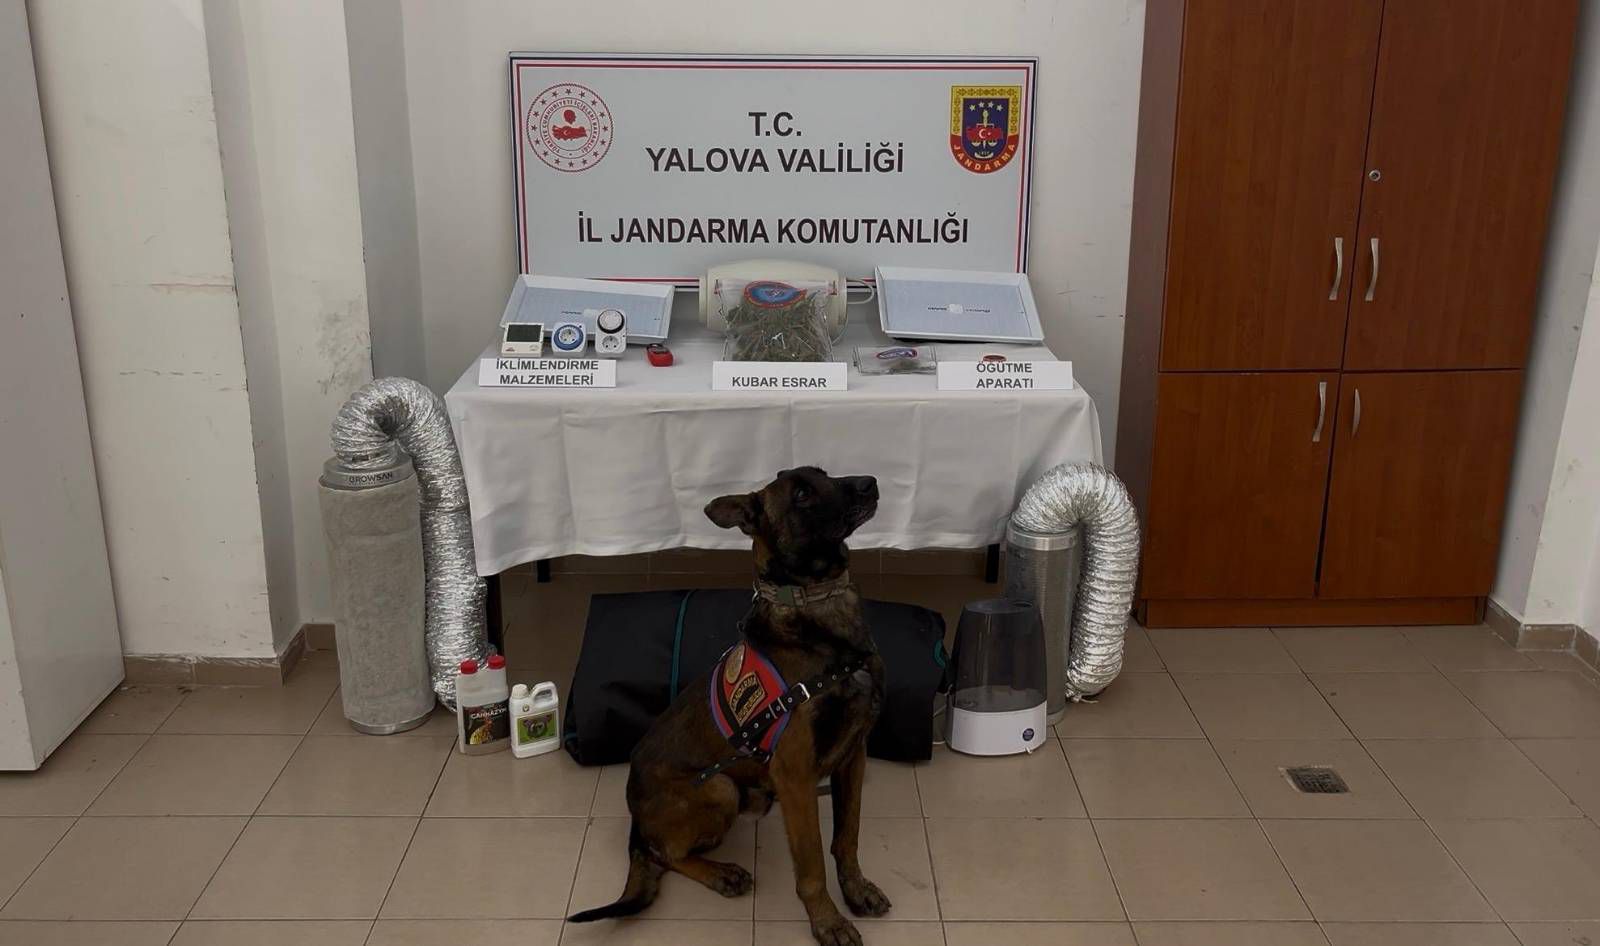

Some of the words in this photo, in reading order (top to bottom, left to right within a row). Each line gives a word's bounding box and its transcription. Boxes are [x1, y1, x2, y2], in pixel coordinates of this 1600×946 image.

[748, 111, 802, 137] T.C.
[645, 147, 770, 173] YALOVA
[777, 142, 904, 173] VALİLİĞİ
[953, 144, 1015, 171] JANDARMA
[578, 211, 602, 242] İL
[610, 217, 770, 243] JANDARMA
[777, 212, 968, 244] KOMUTANLIĞI
[495, 358, 600, 370] İKLİMLENDİRME
[499, 373, 594, 386] MALZEMELERİ
[732, 376, 779, 387] KUBAR
[781, 377, 828, 388] ESRAR
[976, 378, 1034, 389] APARATI
